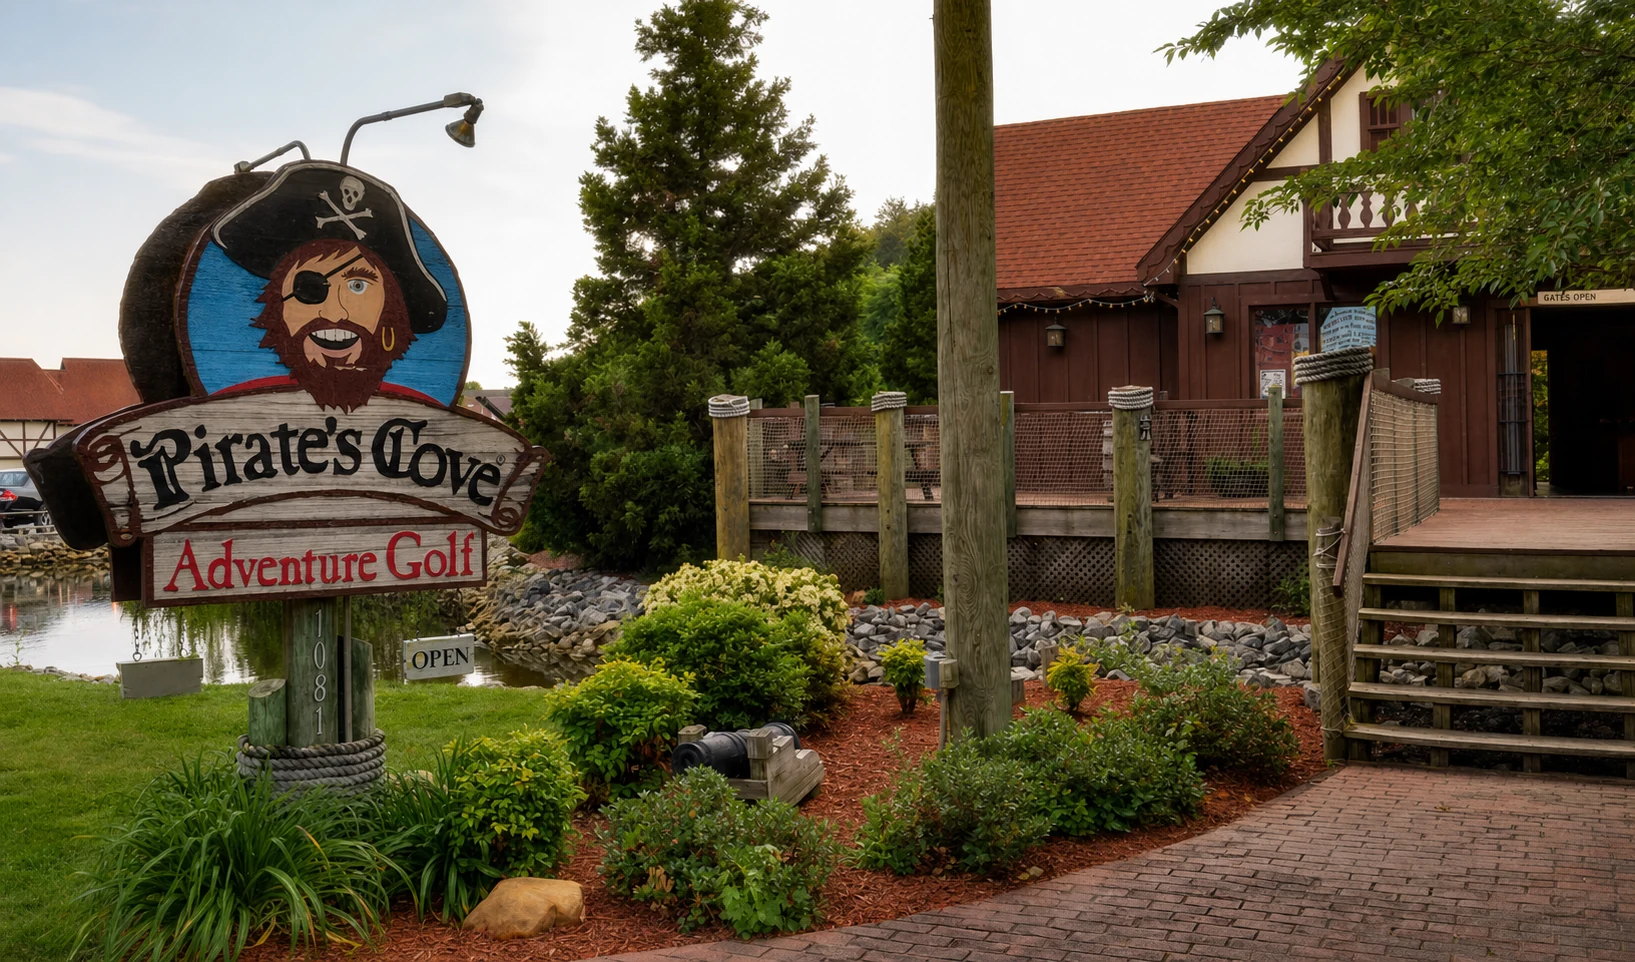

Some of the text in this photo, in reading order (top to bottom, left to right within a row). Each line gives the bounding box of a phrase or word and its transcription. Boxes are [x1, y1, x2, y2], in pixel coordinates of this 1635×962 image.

[1544, 293, 1596, 302] GATES OPEN
[130, 416, 362, 510] Pirate's
[163, 531, 476, 592] Adventure Golf
[314, 608, 326, 736] 1081
[411, 646, 470, 671] OPEN
